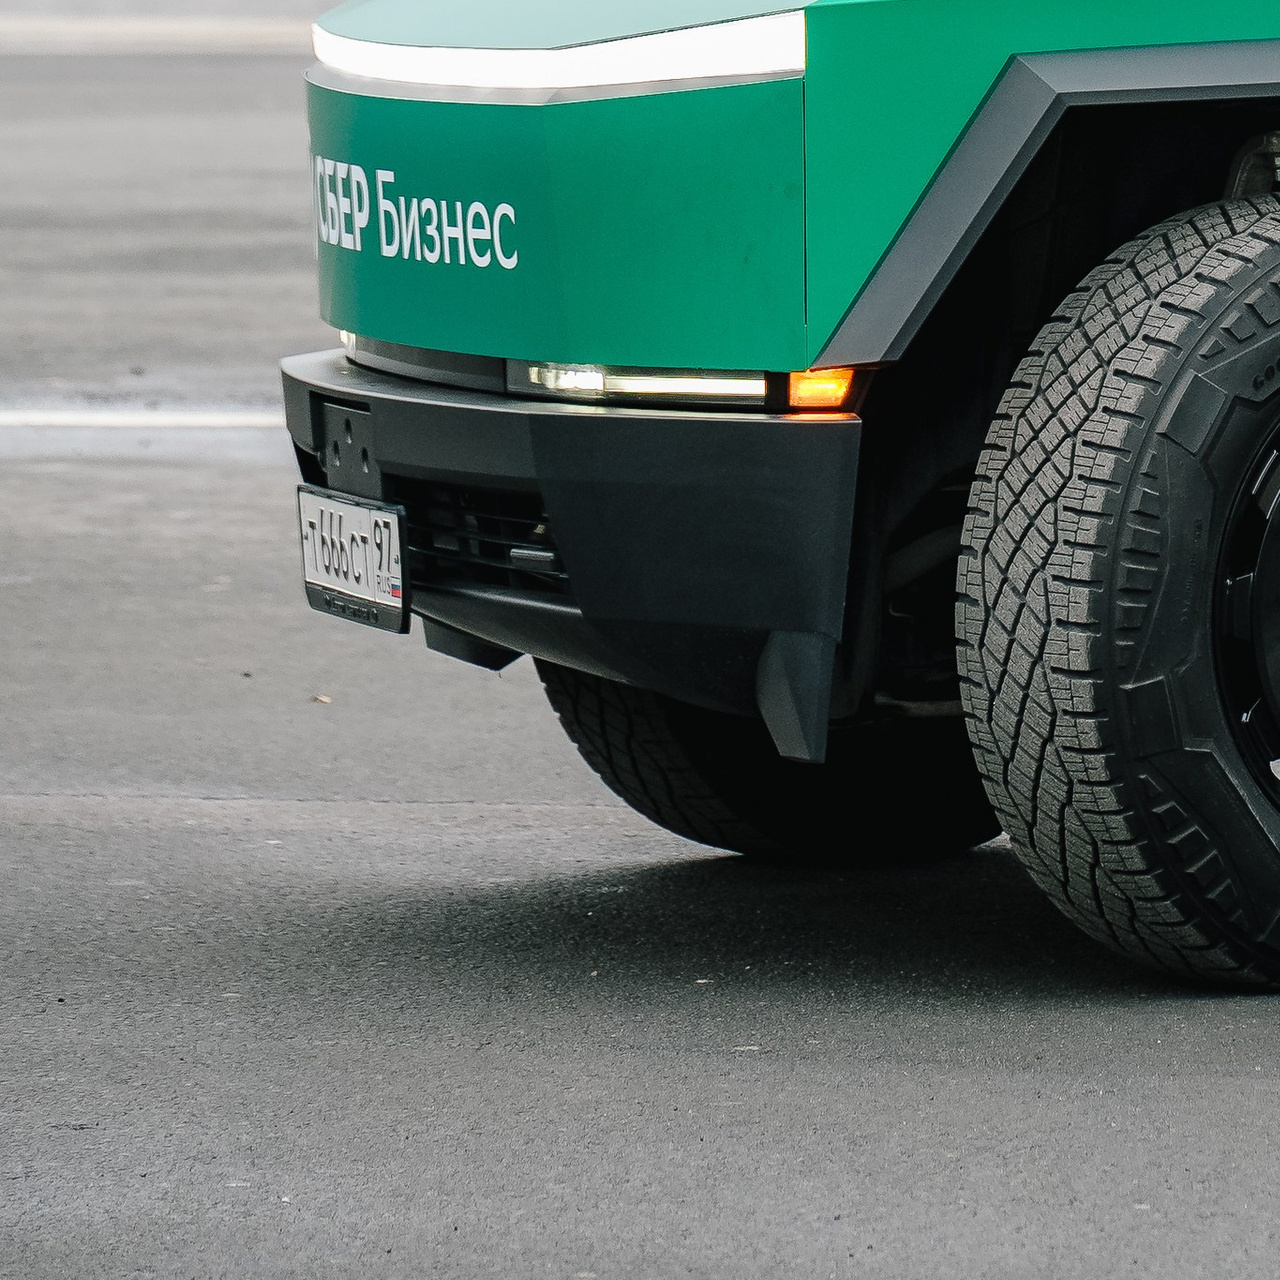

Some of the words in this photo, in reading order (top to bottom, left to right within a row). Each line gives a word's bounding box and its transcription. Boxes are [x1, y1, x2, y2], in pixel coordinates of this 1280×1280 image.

[316, 155, 370, 252] СБЕР
[375, 168, 519, 270] Бизнес
[373, 517, 391, 574] 97
[376, 574, 391, 595] RUS
